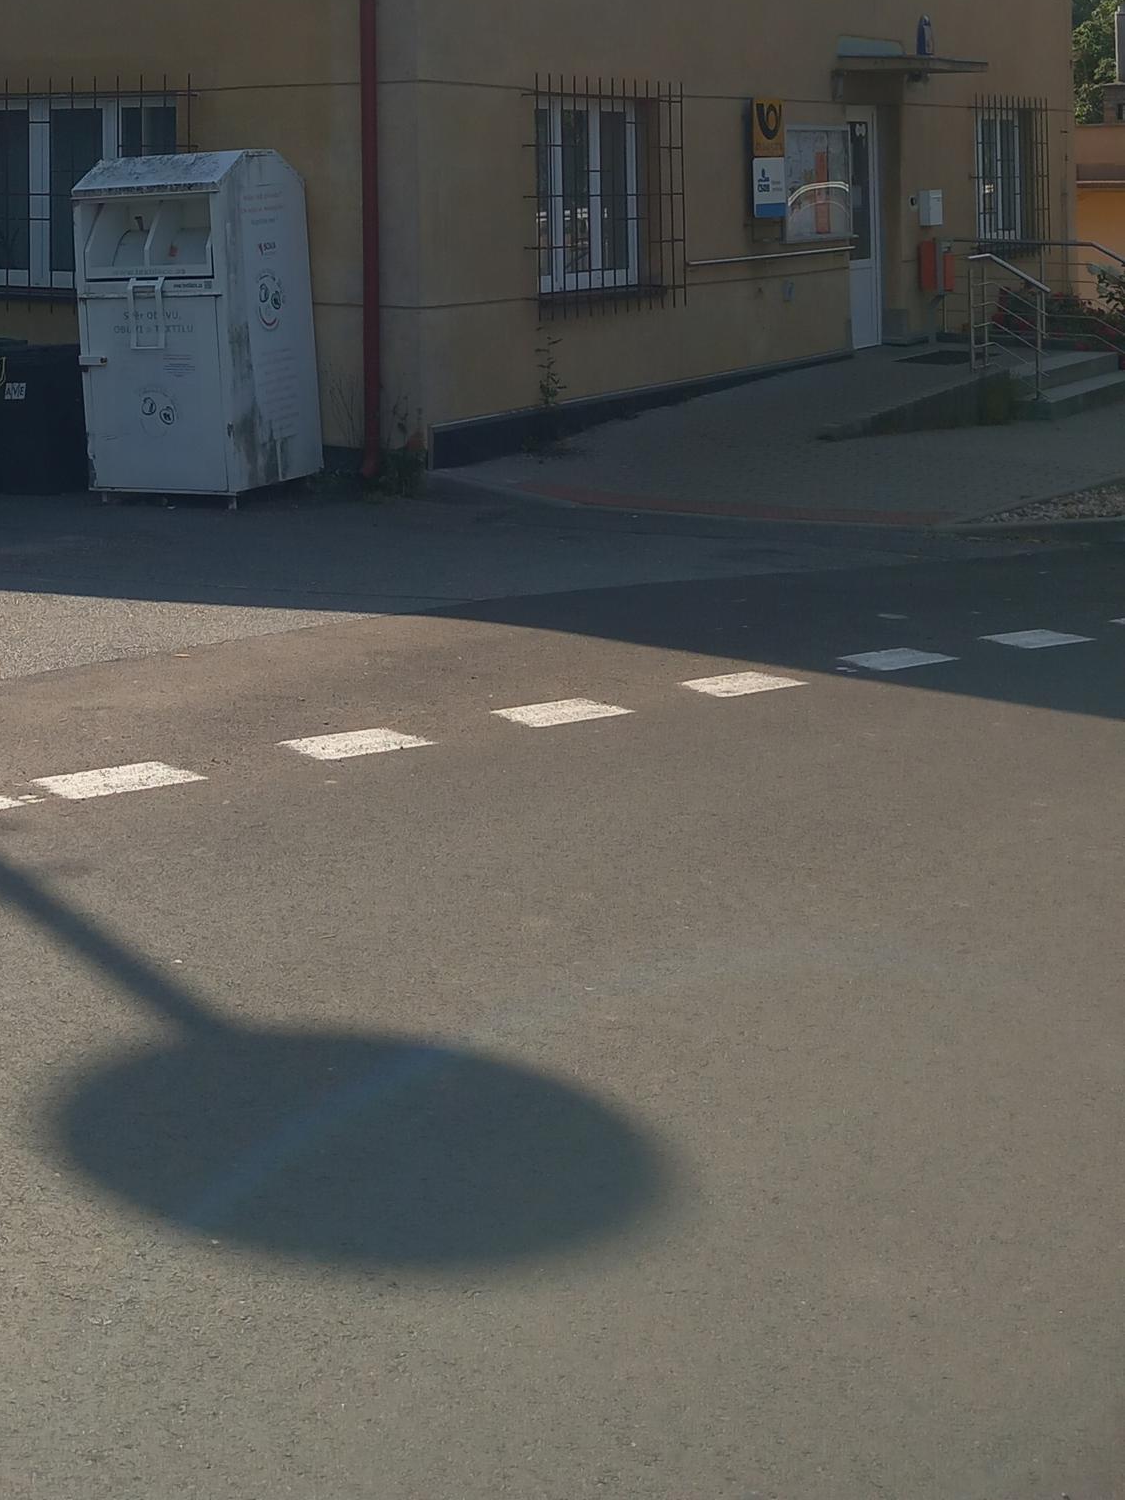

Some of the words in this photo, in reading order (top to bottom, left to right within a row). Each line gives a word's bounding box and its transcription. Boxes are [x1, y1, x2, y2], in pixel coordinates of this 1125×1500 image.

[123, 309, 143, 320] Sěr
[154, 324, 193, 333] TXTILU
[5, 384, 25, 398] AVE
